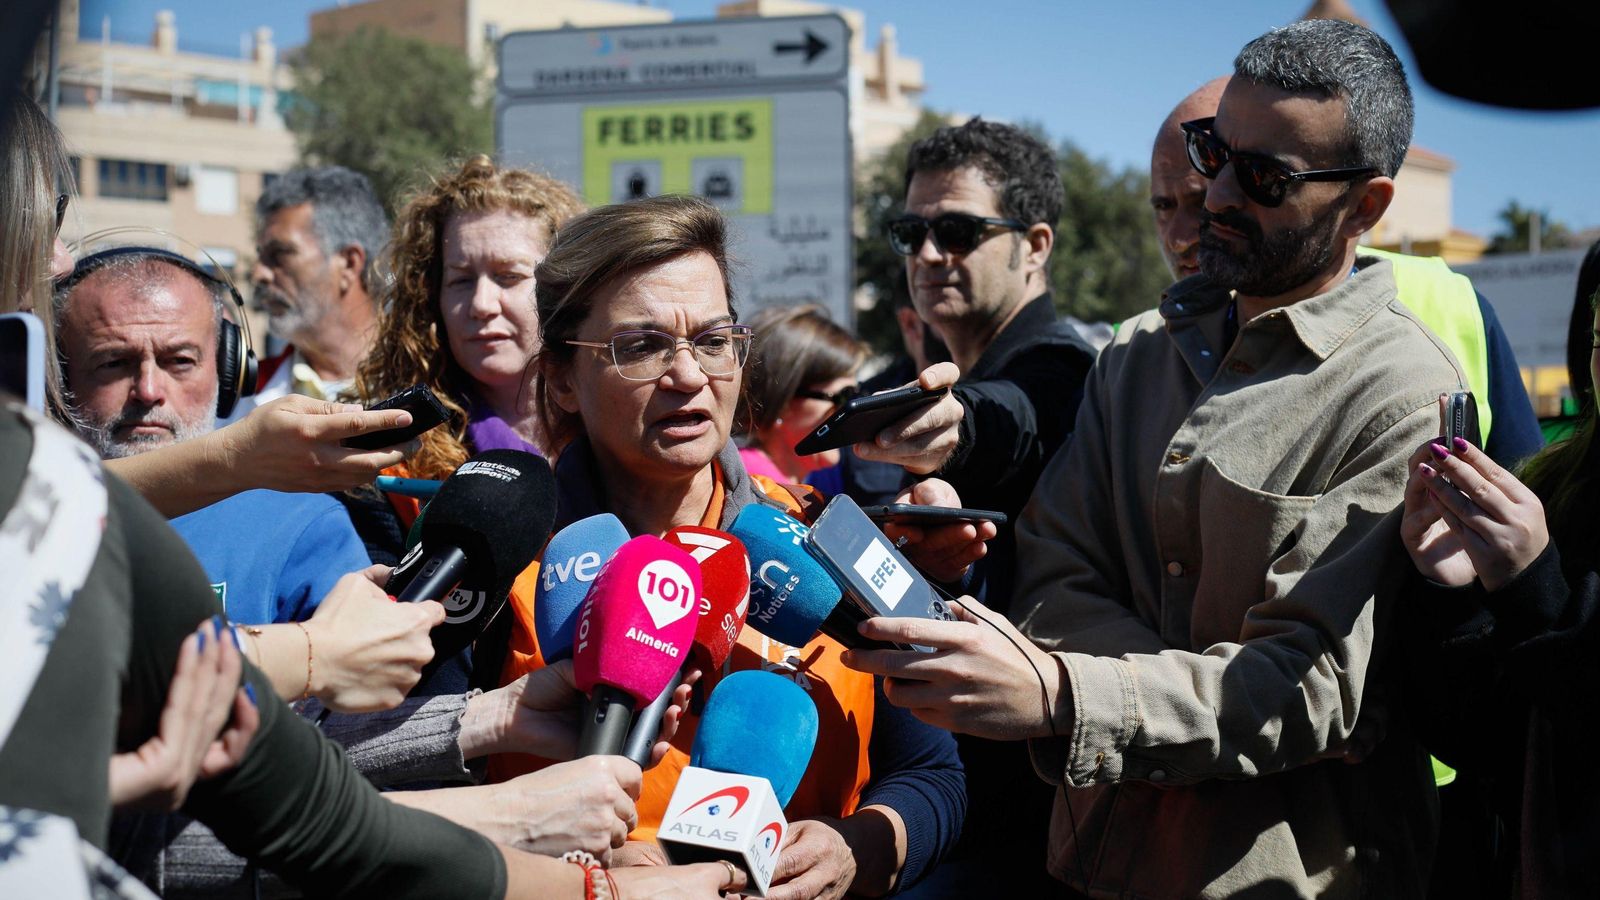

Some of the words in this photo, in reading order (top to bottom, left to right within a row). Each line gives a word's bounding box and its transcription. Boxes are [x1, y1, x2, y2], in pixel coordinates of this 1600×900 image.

[598, 112, 757, 144] FERRIES
[542, 552, 600, 592] tve
[647, 571, 690, 609] 101
[758, 575, 800, 624] Noticias
[625, 626, 680, 658] Almería
[669, 822, 739, 842] ATLAS
[750, 844, 770, 885] ATLAS
